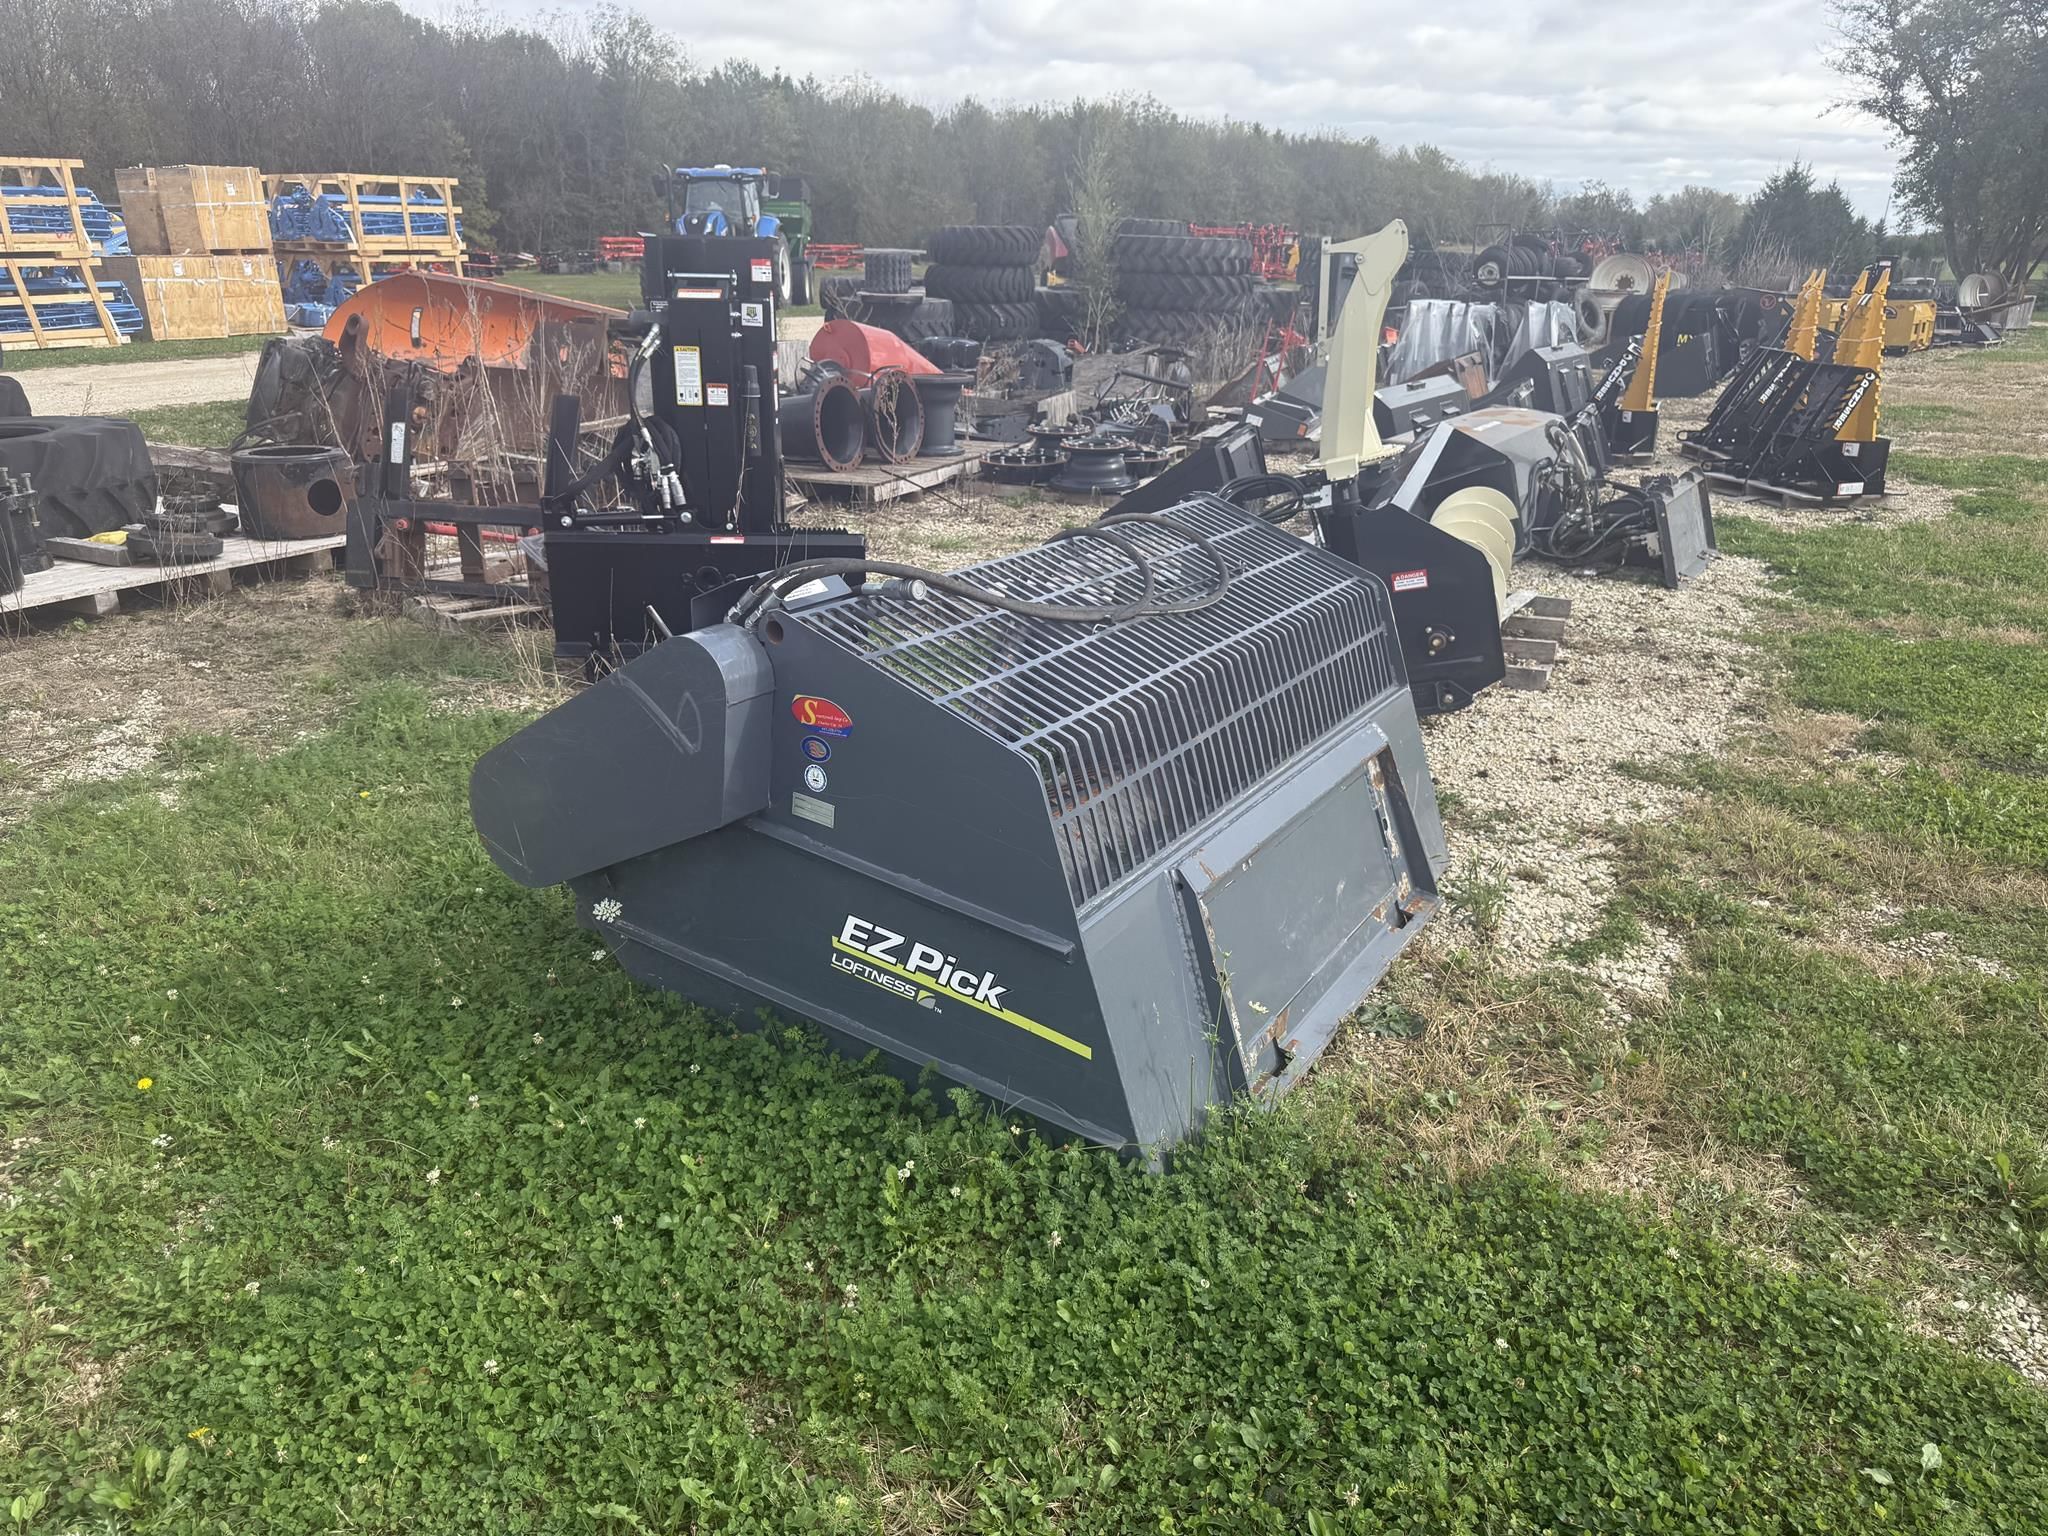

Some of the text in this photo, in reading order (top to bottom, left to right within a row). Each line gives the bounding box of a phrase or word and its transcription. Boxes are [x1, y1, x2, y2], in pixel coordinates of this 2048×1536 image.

[1833, 379, 1869, 429] DANUSER
[1400, 571, 1424, 580] DANGER
[831, 953, 917, 998] LOFTNESS
[839, 915, 1007, 1010] EZ Pick
